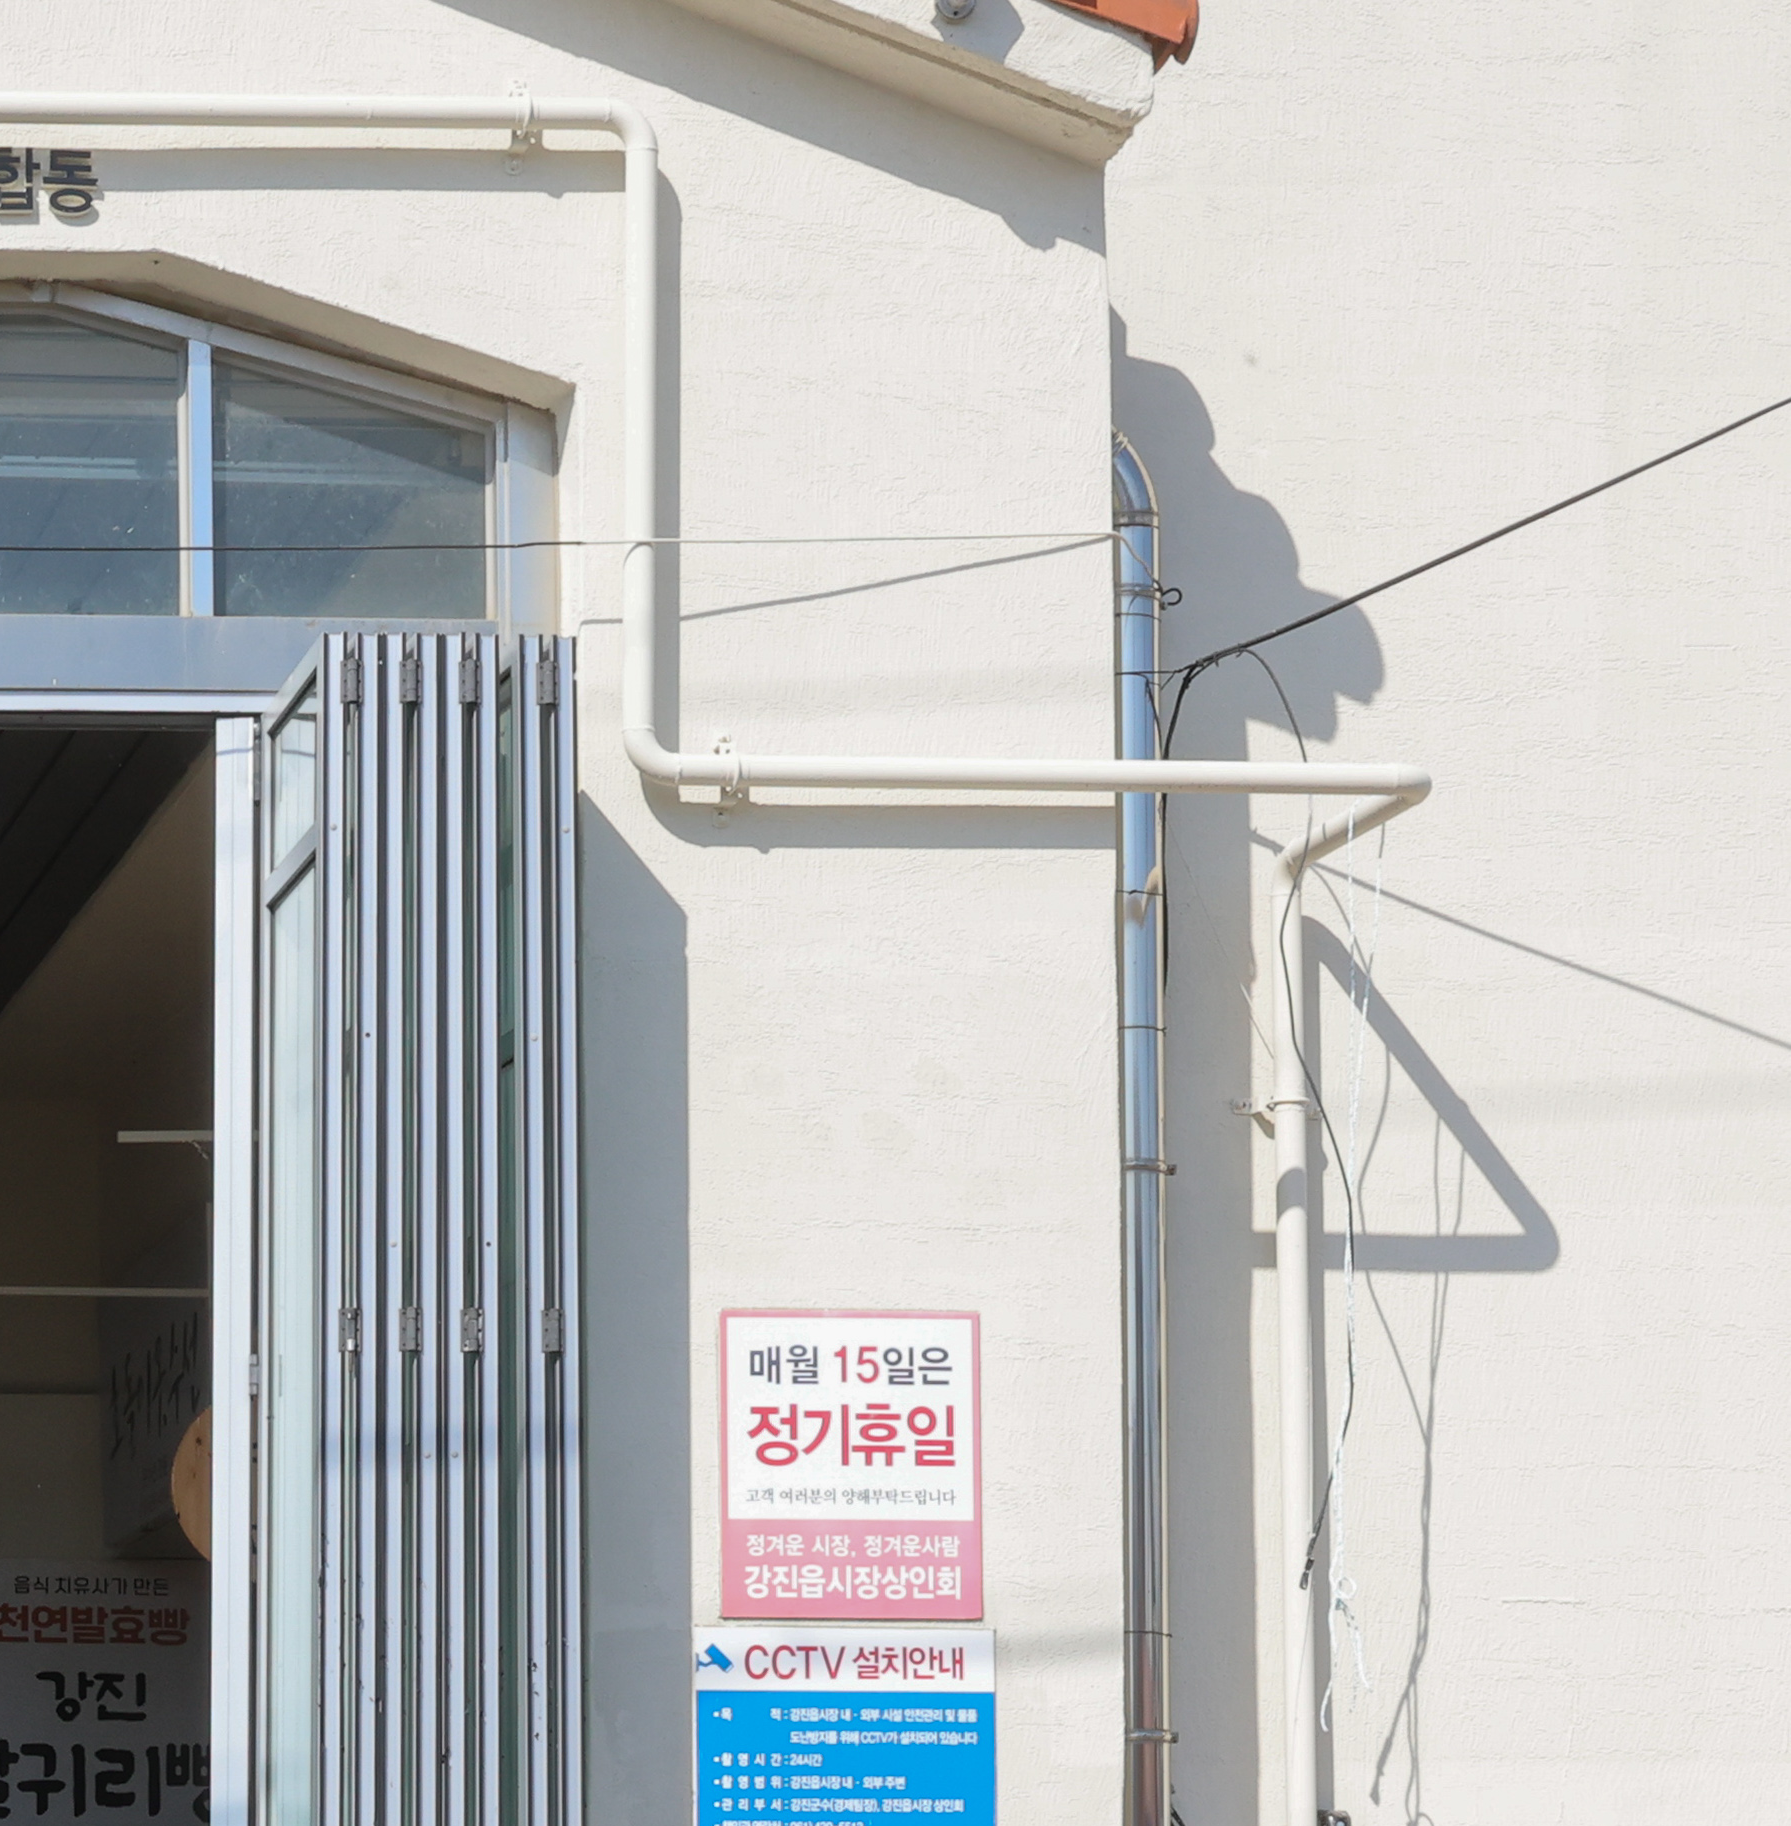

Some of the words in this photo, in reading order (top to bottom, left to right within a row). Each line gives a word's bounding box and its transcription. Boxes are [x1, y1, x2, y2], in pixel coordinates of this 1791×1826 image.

[749, 1345, 820, 1385] 매월
[833, 1345, 953, 1385] 15일은
[747, 1403, 956, 1467] 정기휴일
[746, 1488, 775, 1504] 고객
[779, 1488, 837, 1505] 여러분의
[841, 1488, 957, 1506] 양해부탁드립니다
[746, 1533, 805, 1557] 정겨운
[864, 1535, 961, 1558] 정겨운사람
[13, 1575, 50, 1595] 음식
[54, 1576, 128, 1596] 치유사가
[133, 1578, 170, 1596] 만든
[744, 1564, 962, 1600] 강진읍시장상인회
[744, 1645, 846, 1680] CCTV
[852, 1646, 964, 1681] 설치안내
[35, 1671, 147, 1722] 강진
[790, 1708, 839, 1722] 강진읍시장
